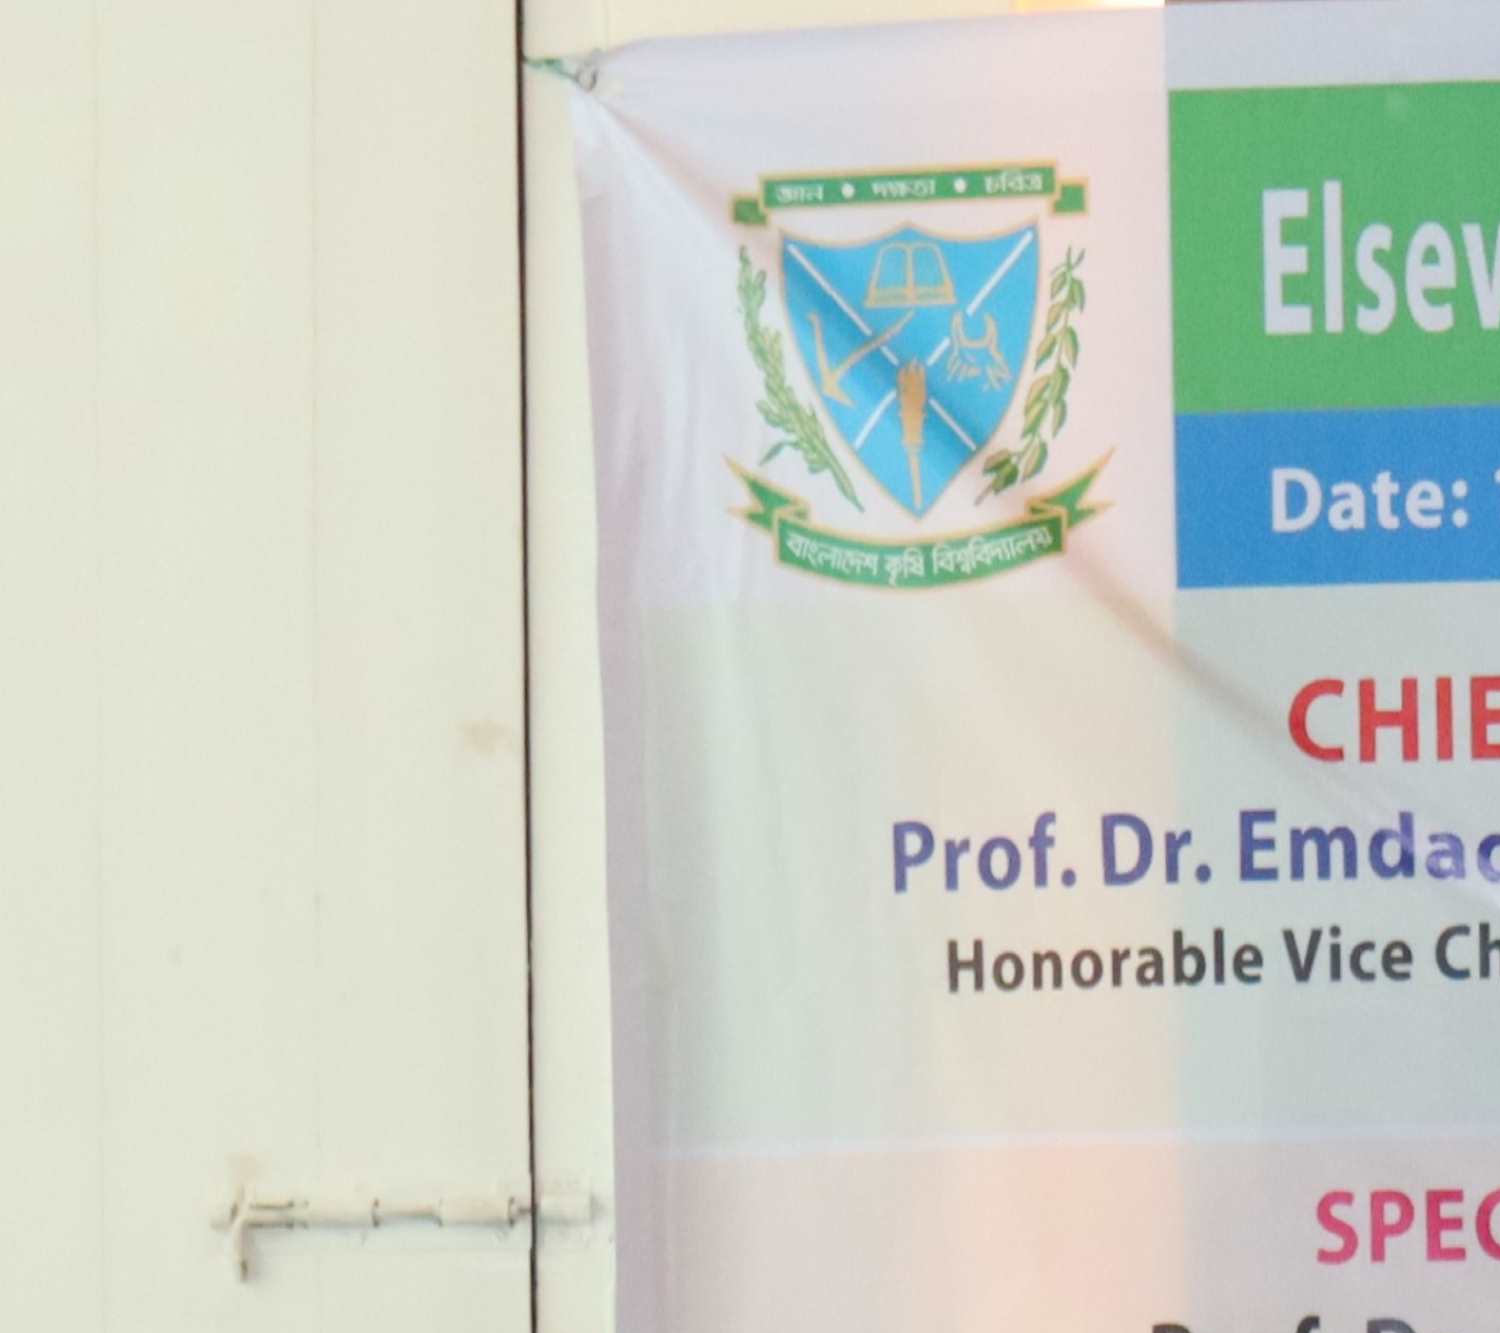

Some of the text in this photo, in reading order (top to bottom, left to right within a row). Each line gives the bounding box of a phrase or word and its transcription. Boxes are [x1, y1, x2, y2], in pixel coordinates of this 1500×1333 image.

[1272, 468, 1468, 532] Date:
[786, 531, 879, 577] বাংলাদেশ
[884, 546, 925, 587] কৃষি
[893, 812, 1076, 893] Prof.
[1102, 813, 1211, 885] Dr.
[948, 928, 1263, 992] Honorable
[1283, 926, 1413, 982] Vice
